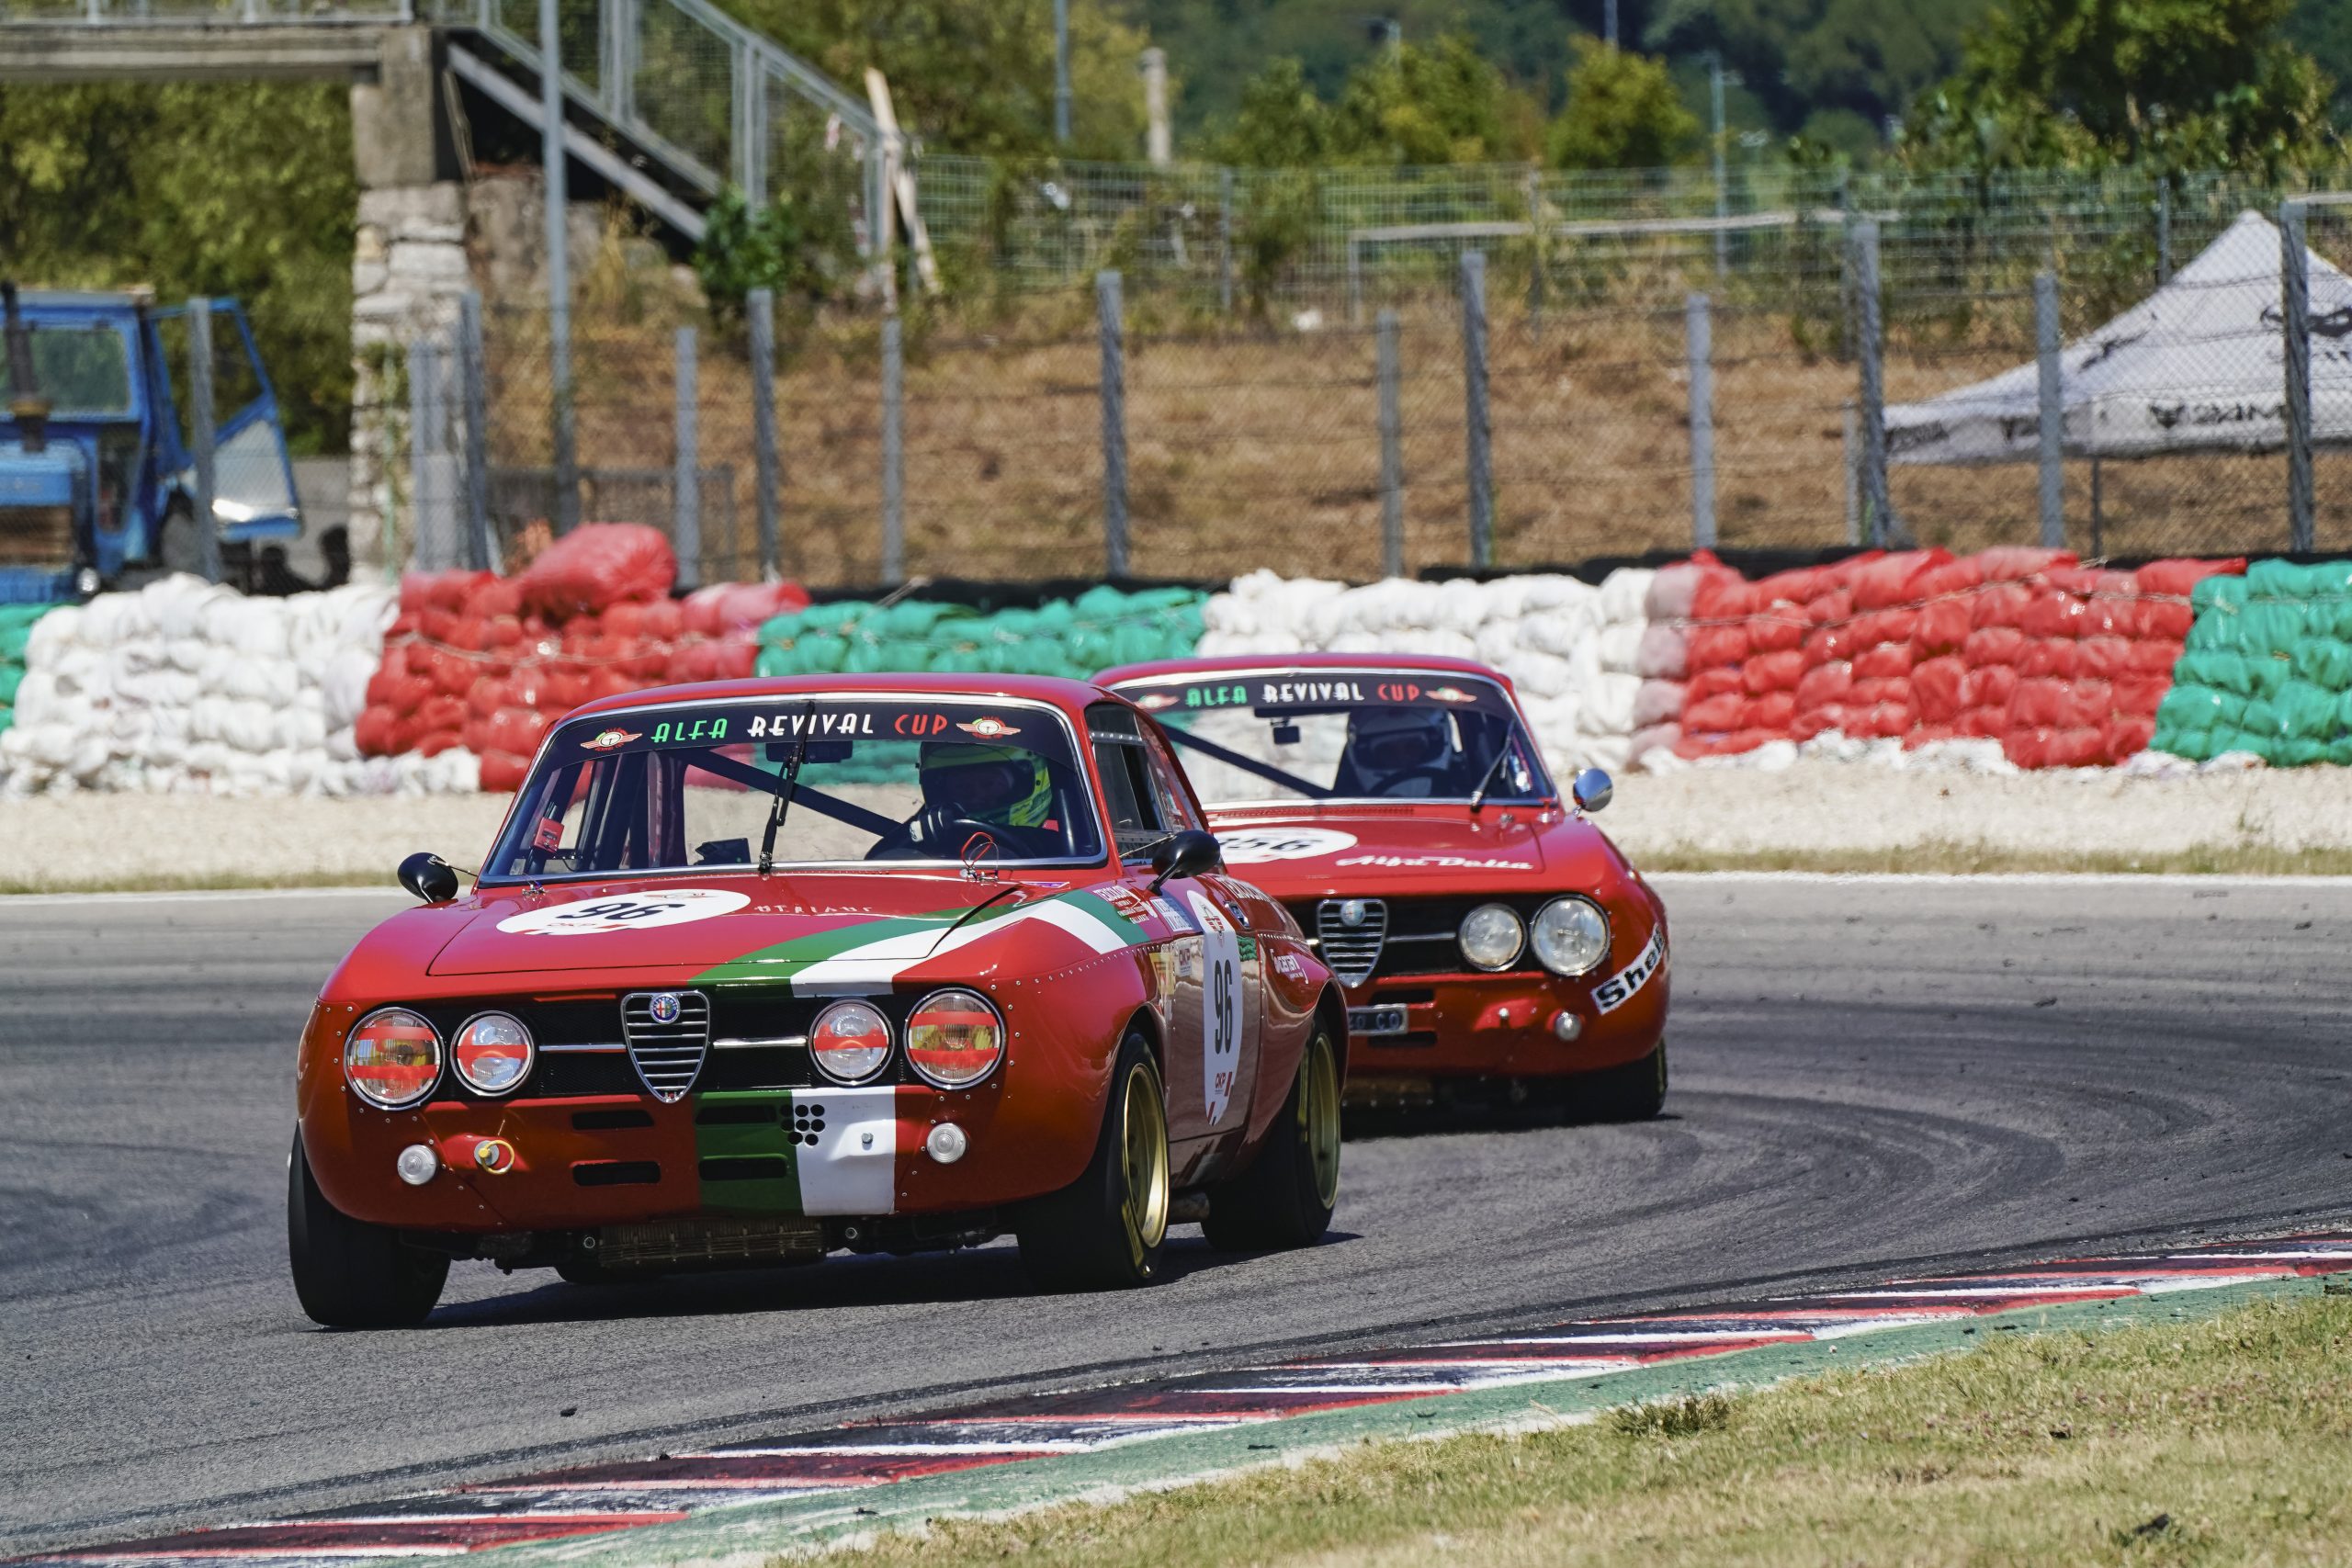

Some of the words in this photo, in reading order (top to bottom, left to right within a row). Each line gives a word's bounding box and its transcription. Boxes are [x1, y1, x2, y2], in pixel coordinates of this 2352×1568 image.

[1184, 685, 1249, 707] ALFA
[1261, 682, 1365, 704] REVIVAL
[1376, 682, 1421, 702] CUP
[650, 717, 729, 743] ALFA
[746, 713, 875, 739] REVIVAL
[893, 713, 948, 736] CUP
[1335, 855, 1430, 868] Alfa
[555, 902, 687, 920] 96
[1214, 958, 1234, 1055] 96
